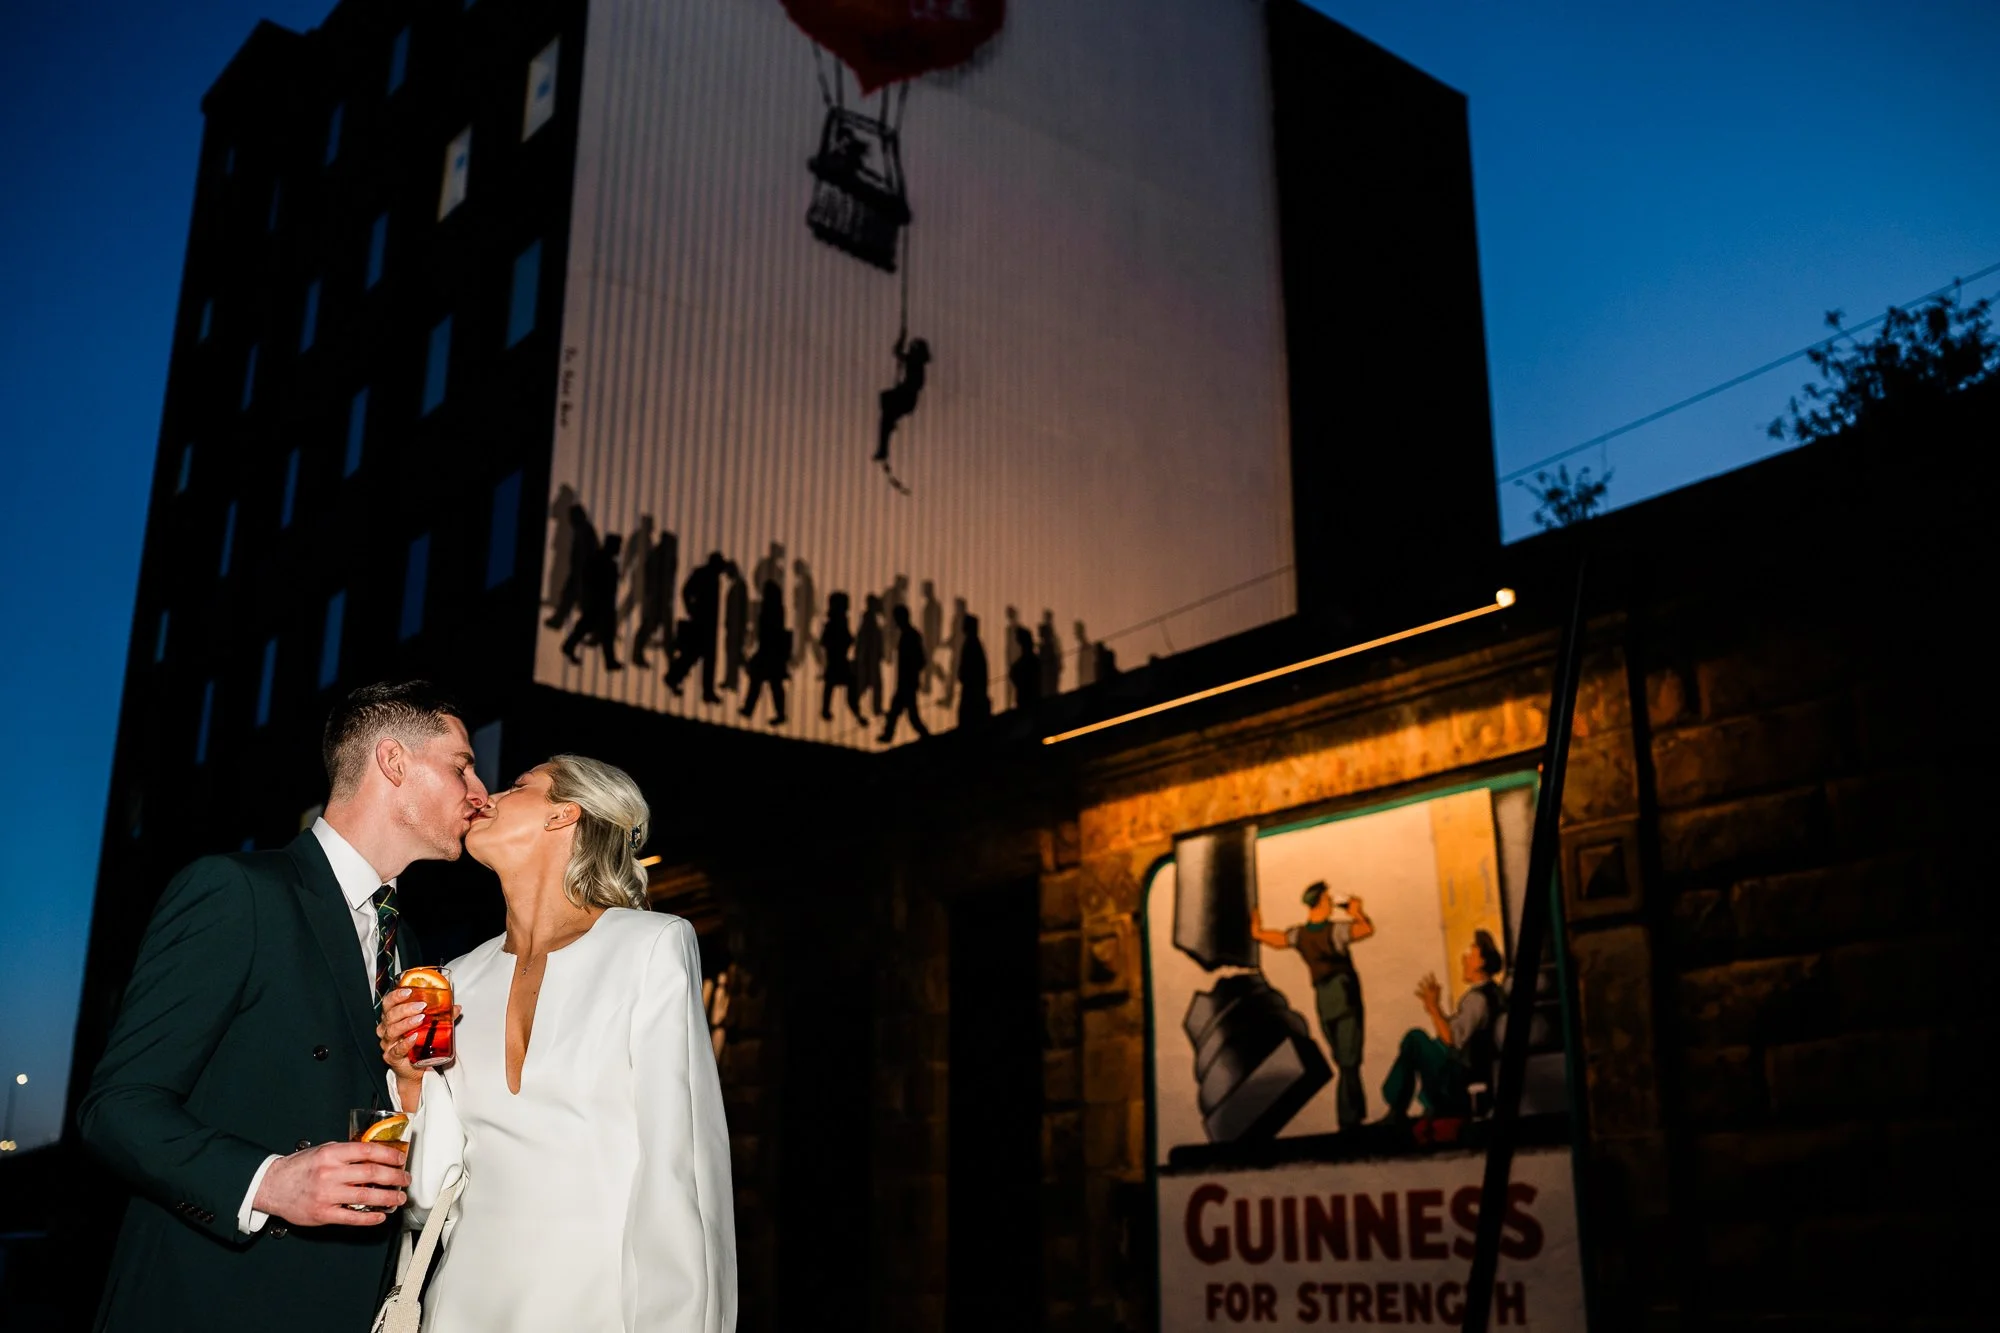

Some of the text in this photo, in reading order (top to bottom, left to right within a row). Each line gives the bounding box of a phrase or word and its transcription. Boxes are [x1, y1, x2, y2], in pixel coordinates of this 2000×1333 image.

[1186, 1184, 1543, 1264] GUINNESS
[1207, 1282, 1526, 1325] FOR STRENGH
